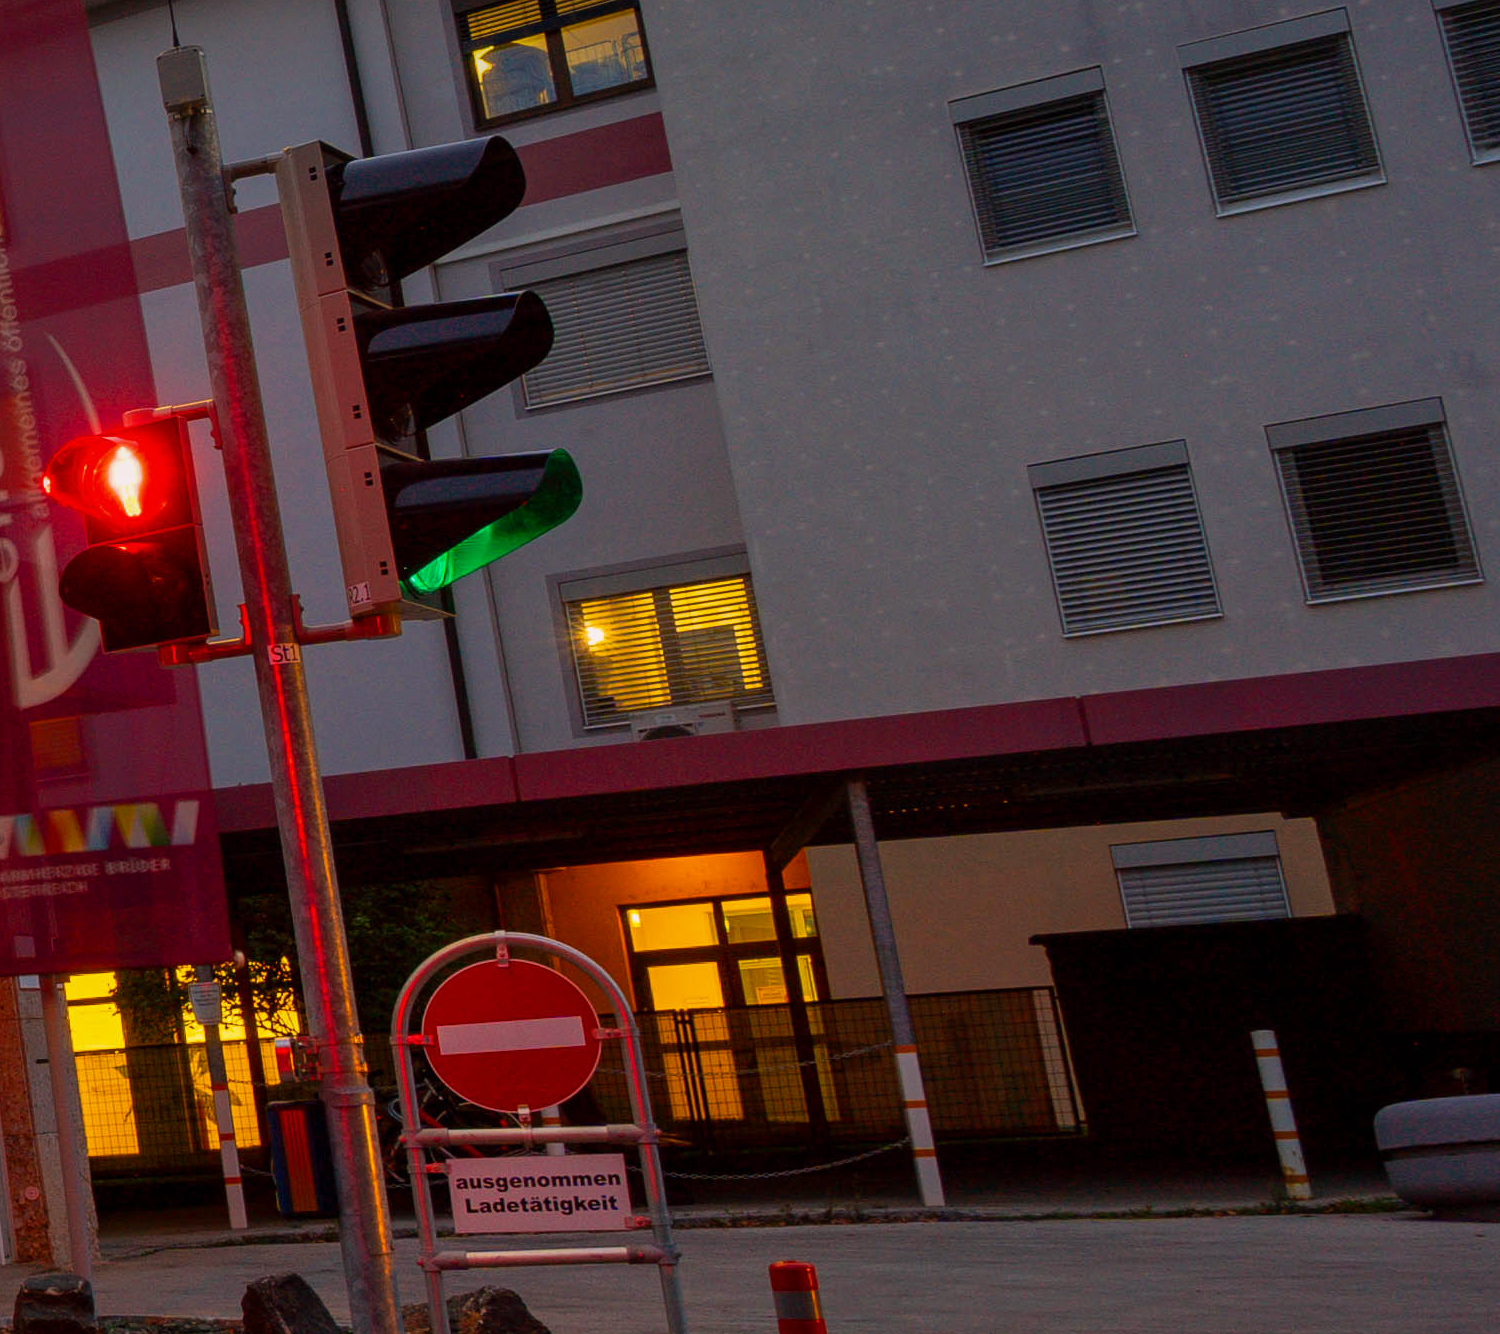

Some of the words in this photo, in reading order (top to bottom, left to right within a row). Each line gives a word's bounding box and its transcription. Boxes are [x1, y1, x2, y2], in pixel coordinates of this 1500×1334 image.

[271, 644, 299, 662] St1
[456, 1173, 621, 1192] ausgenommen
[465, 1195, 618, 1215] Ladetätigkeit
